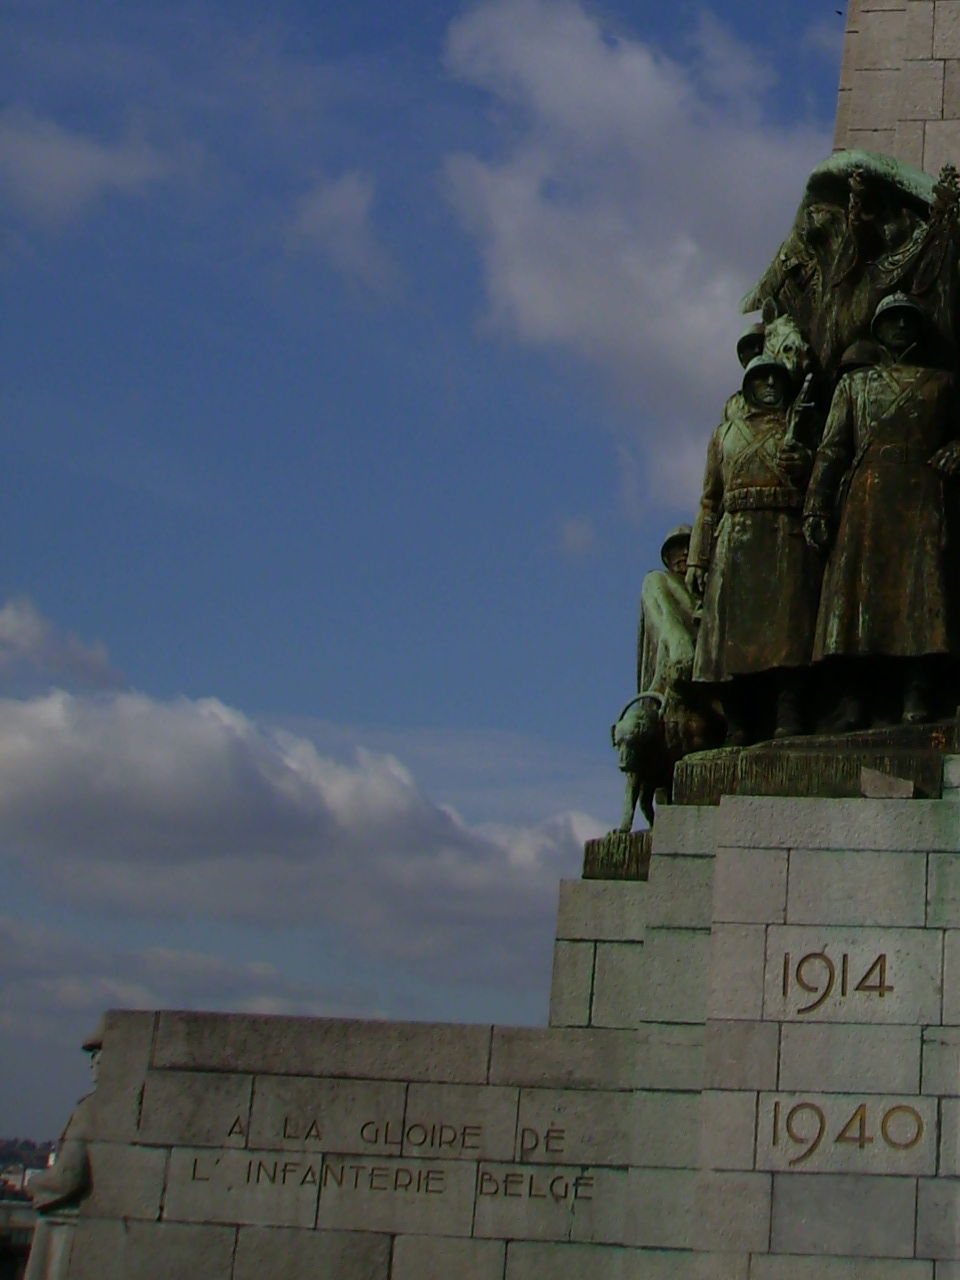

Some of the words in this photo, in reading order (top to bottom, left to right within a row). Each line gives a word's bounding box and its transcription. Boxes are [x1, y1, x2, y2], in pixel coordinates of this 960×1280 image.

[781, 950, 894, 1015] 1914
[226, 1114, 246, 1138] A
[282, 1116, 323, 1142] LA
[359, 1119, 483, 1150] GLOIRE
[520, 1126, 566, 1154] DE
[771, 1100, 923, 1166] 1940
[245, 1159, 448, 1195] INFANTERIE
[479, 1172, 596, 1201] BELGE
